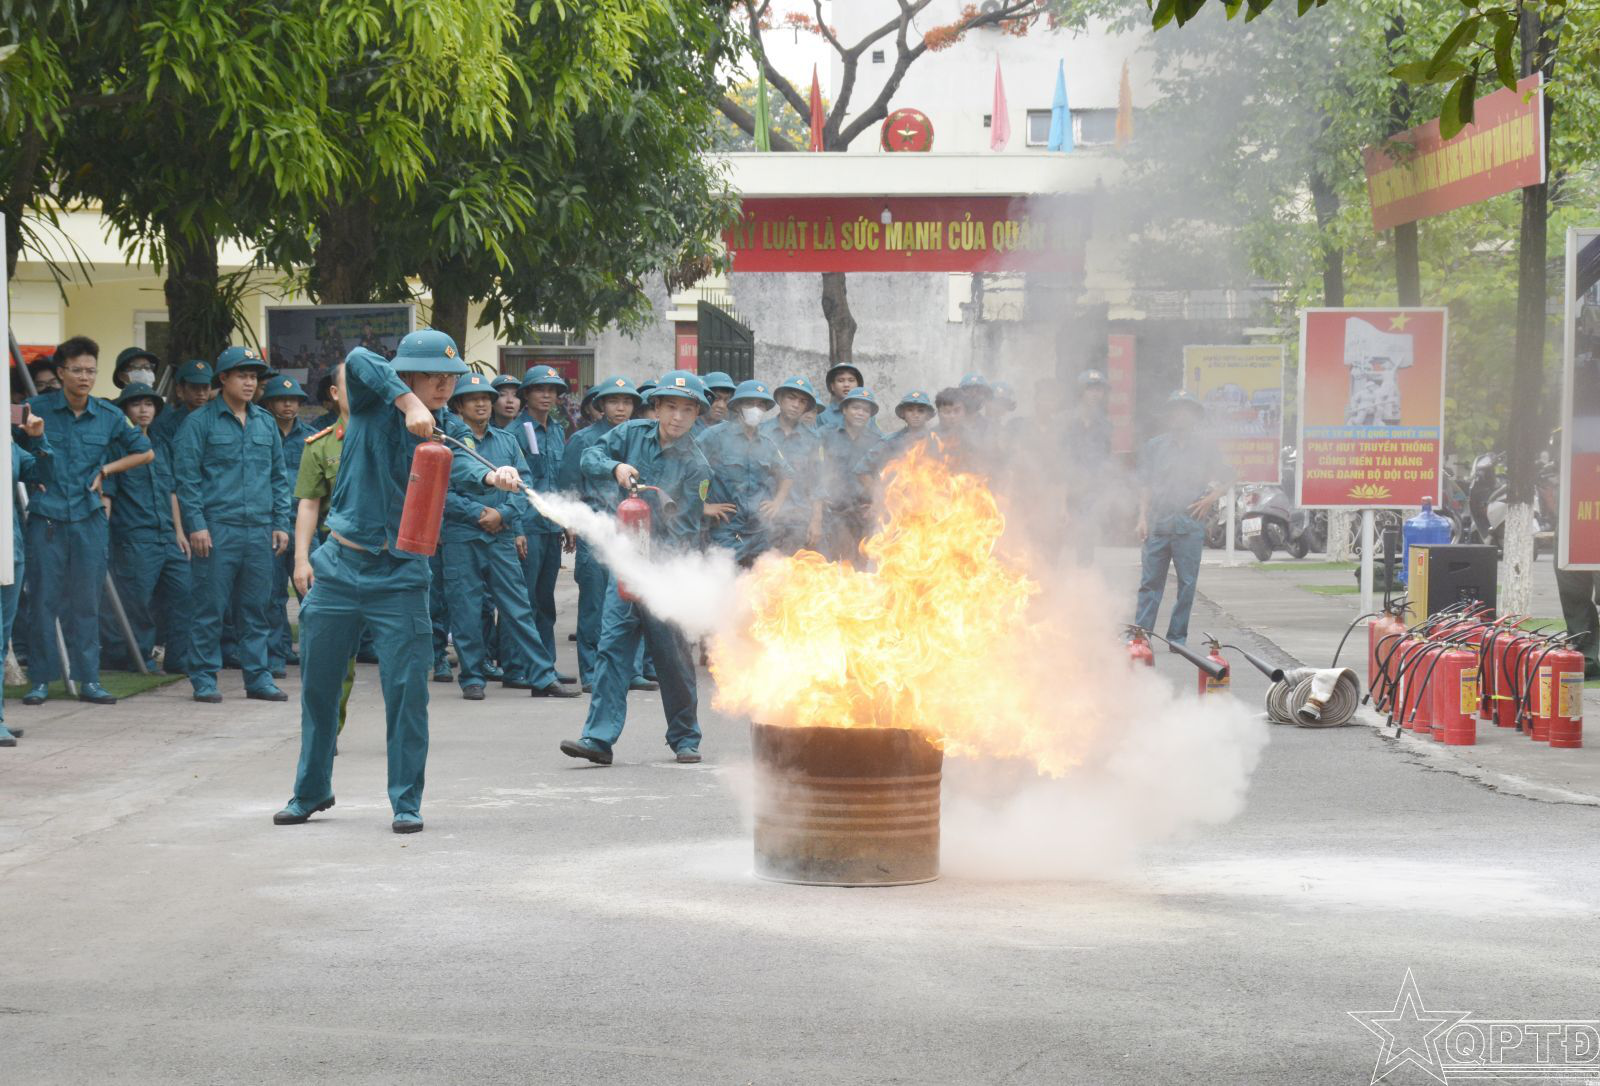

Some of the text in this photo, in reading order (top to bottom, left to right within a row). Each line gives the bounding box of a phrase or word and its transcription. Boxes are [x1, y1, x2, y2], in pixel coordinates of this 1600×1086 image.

[732, 211, 756, 250] KỶ
[763, 215, 808, 257] LUẬT
[813, 216, 836, 250] LÀ
[841, 215, 880, 251] SỨC
[885, 221, 943, 257] MẠNH
[948, 212, 987, 251] CỦA
[1336, 441, 1356, 452] HUY
[1336, 469, 1365, 480] DANH
[1367, 468, 1381, 481] BỘ
[1404, 469, 1417, 481] CỤ
